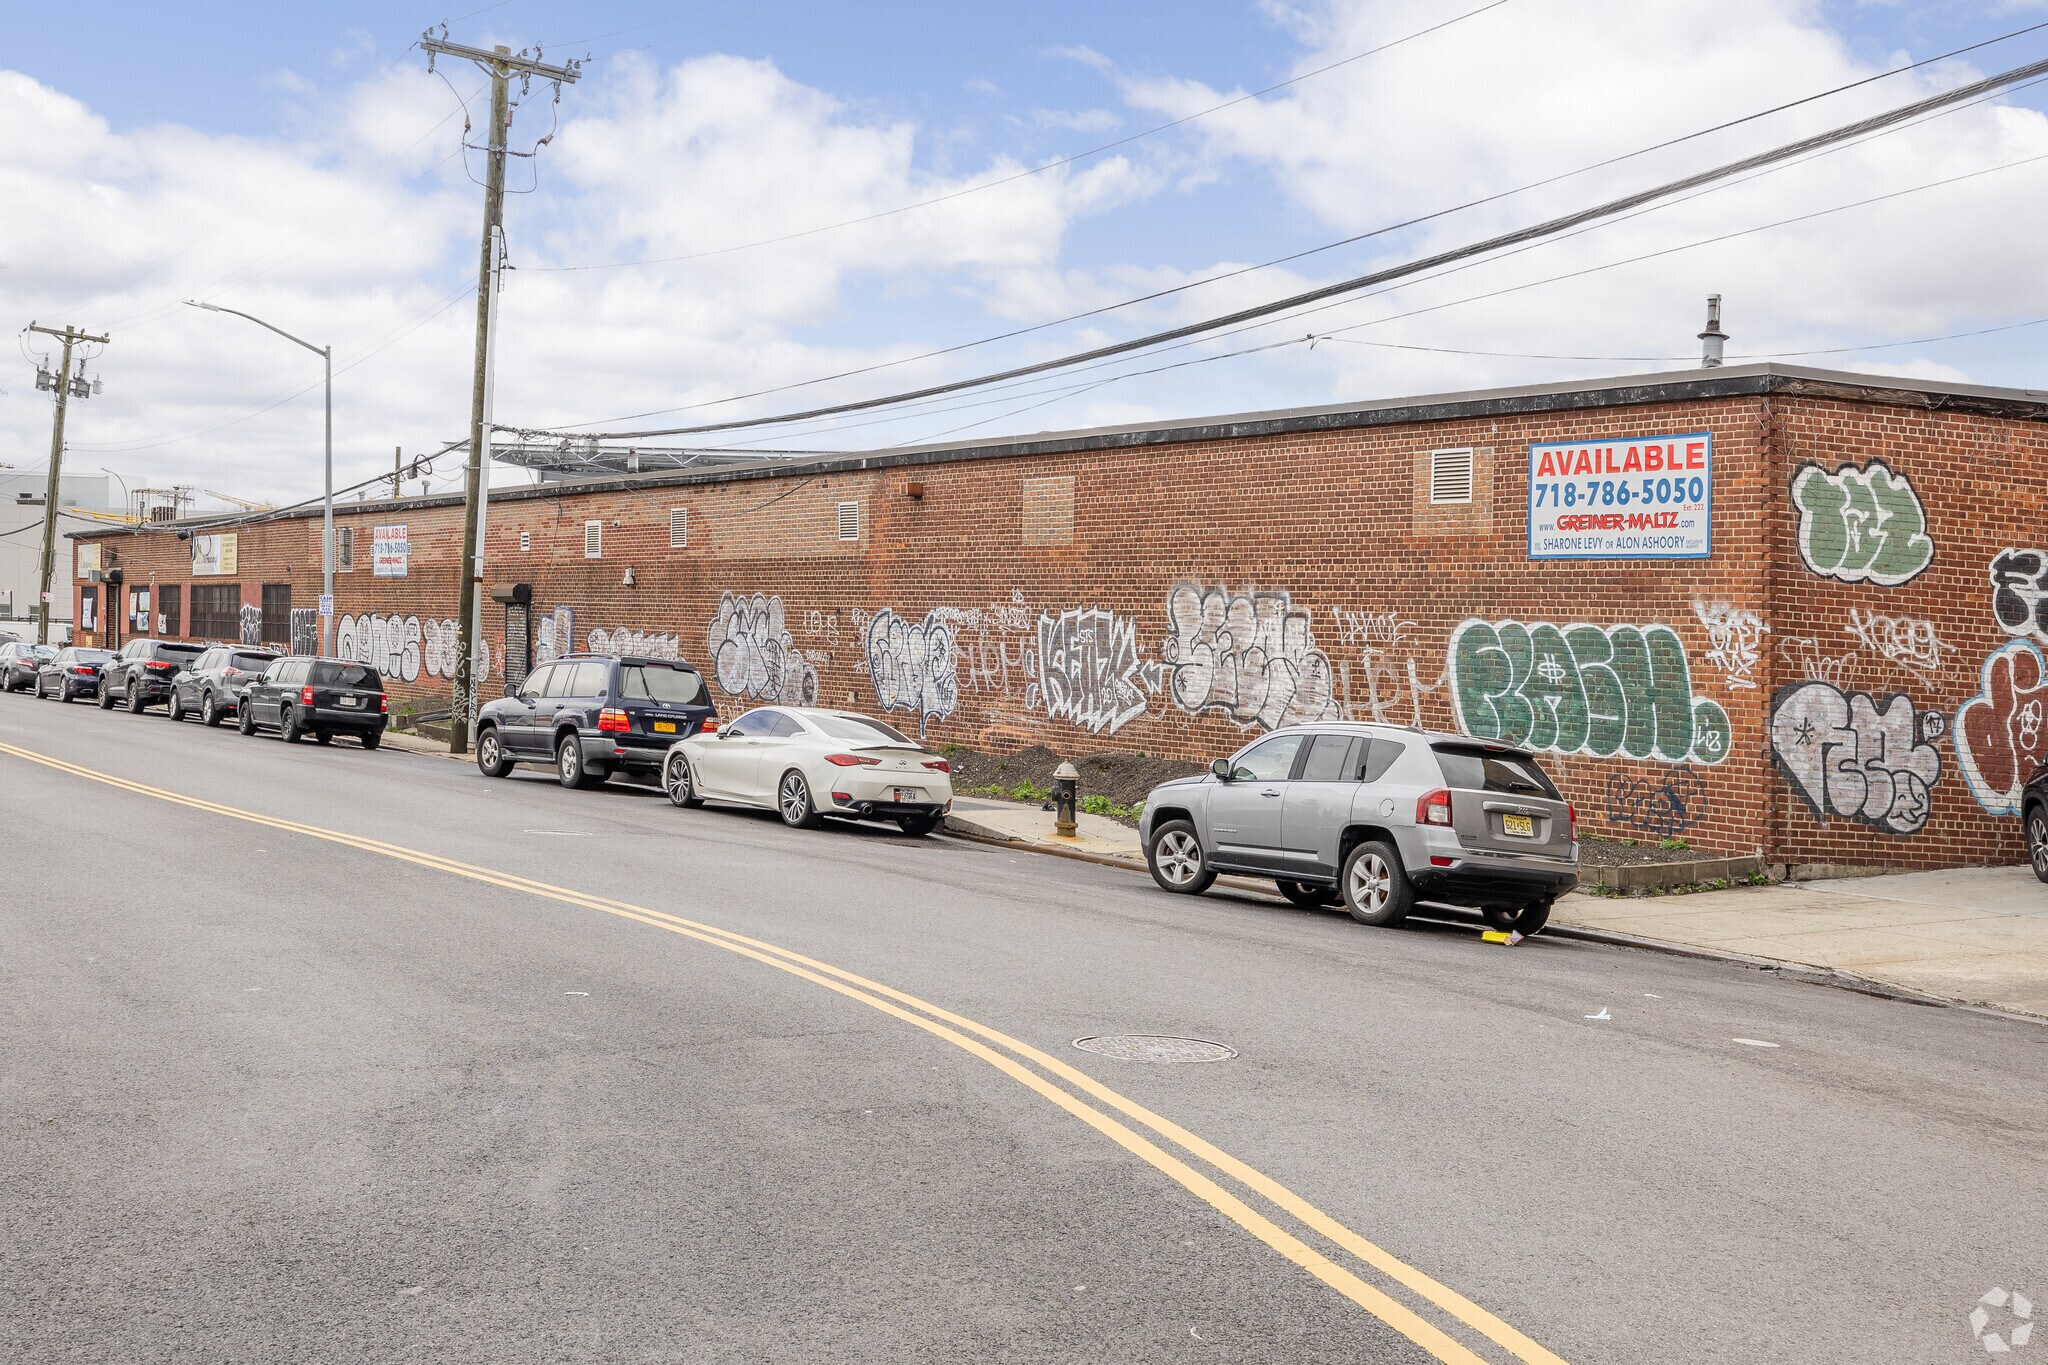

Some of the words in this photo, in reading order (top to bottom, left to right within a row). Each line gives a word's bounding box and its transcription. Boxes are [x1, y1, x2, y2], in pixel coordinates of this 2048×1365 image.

[1537, 442, 1705, 477] AVAILABLE
[1535, 476, 1704, 508] 718-786-5050
[1556, 511, 1680, 532] GREINER-MALTZ
[375, 528, 406, 540] AVAILABLE
[1543, 538, 1582, 550] SHARONE
[1583, 537, 1603, 550] LEVY
[1605, 541, 1614, 549] OR
[1616, 536, 1640, 549] ALON
[1642, 536, 1685, 549] ASHOORY
